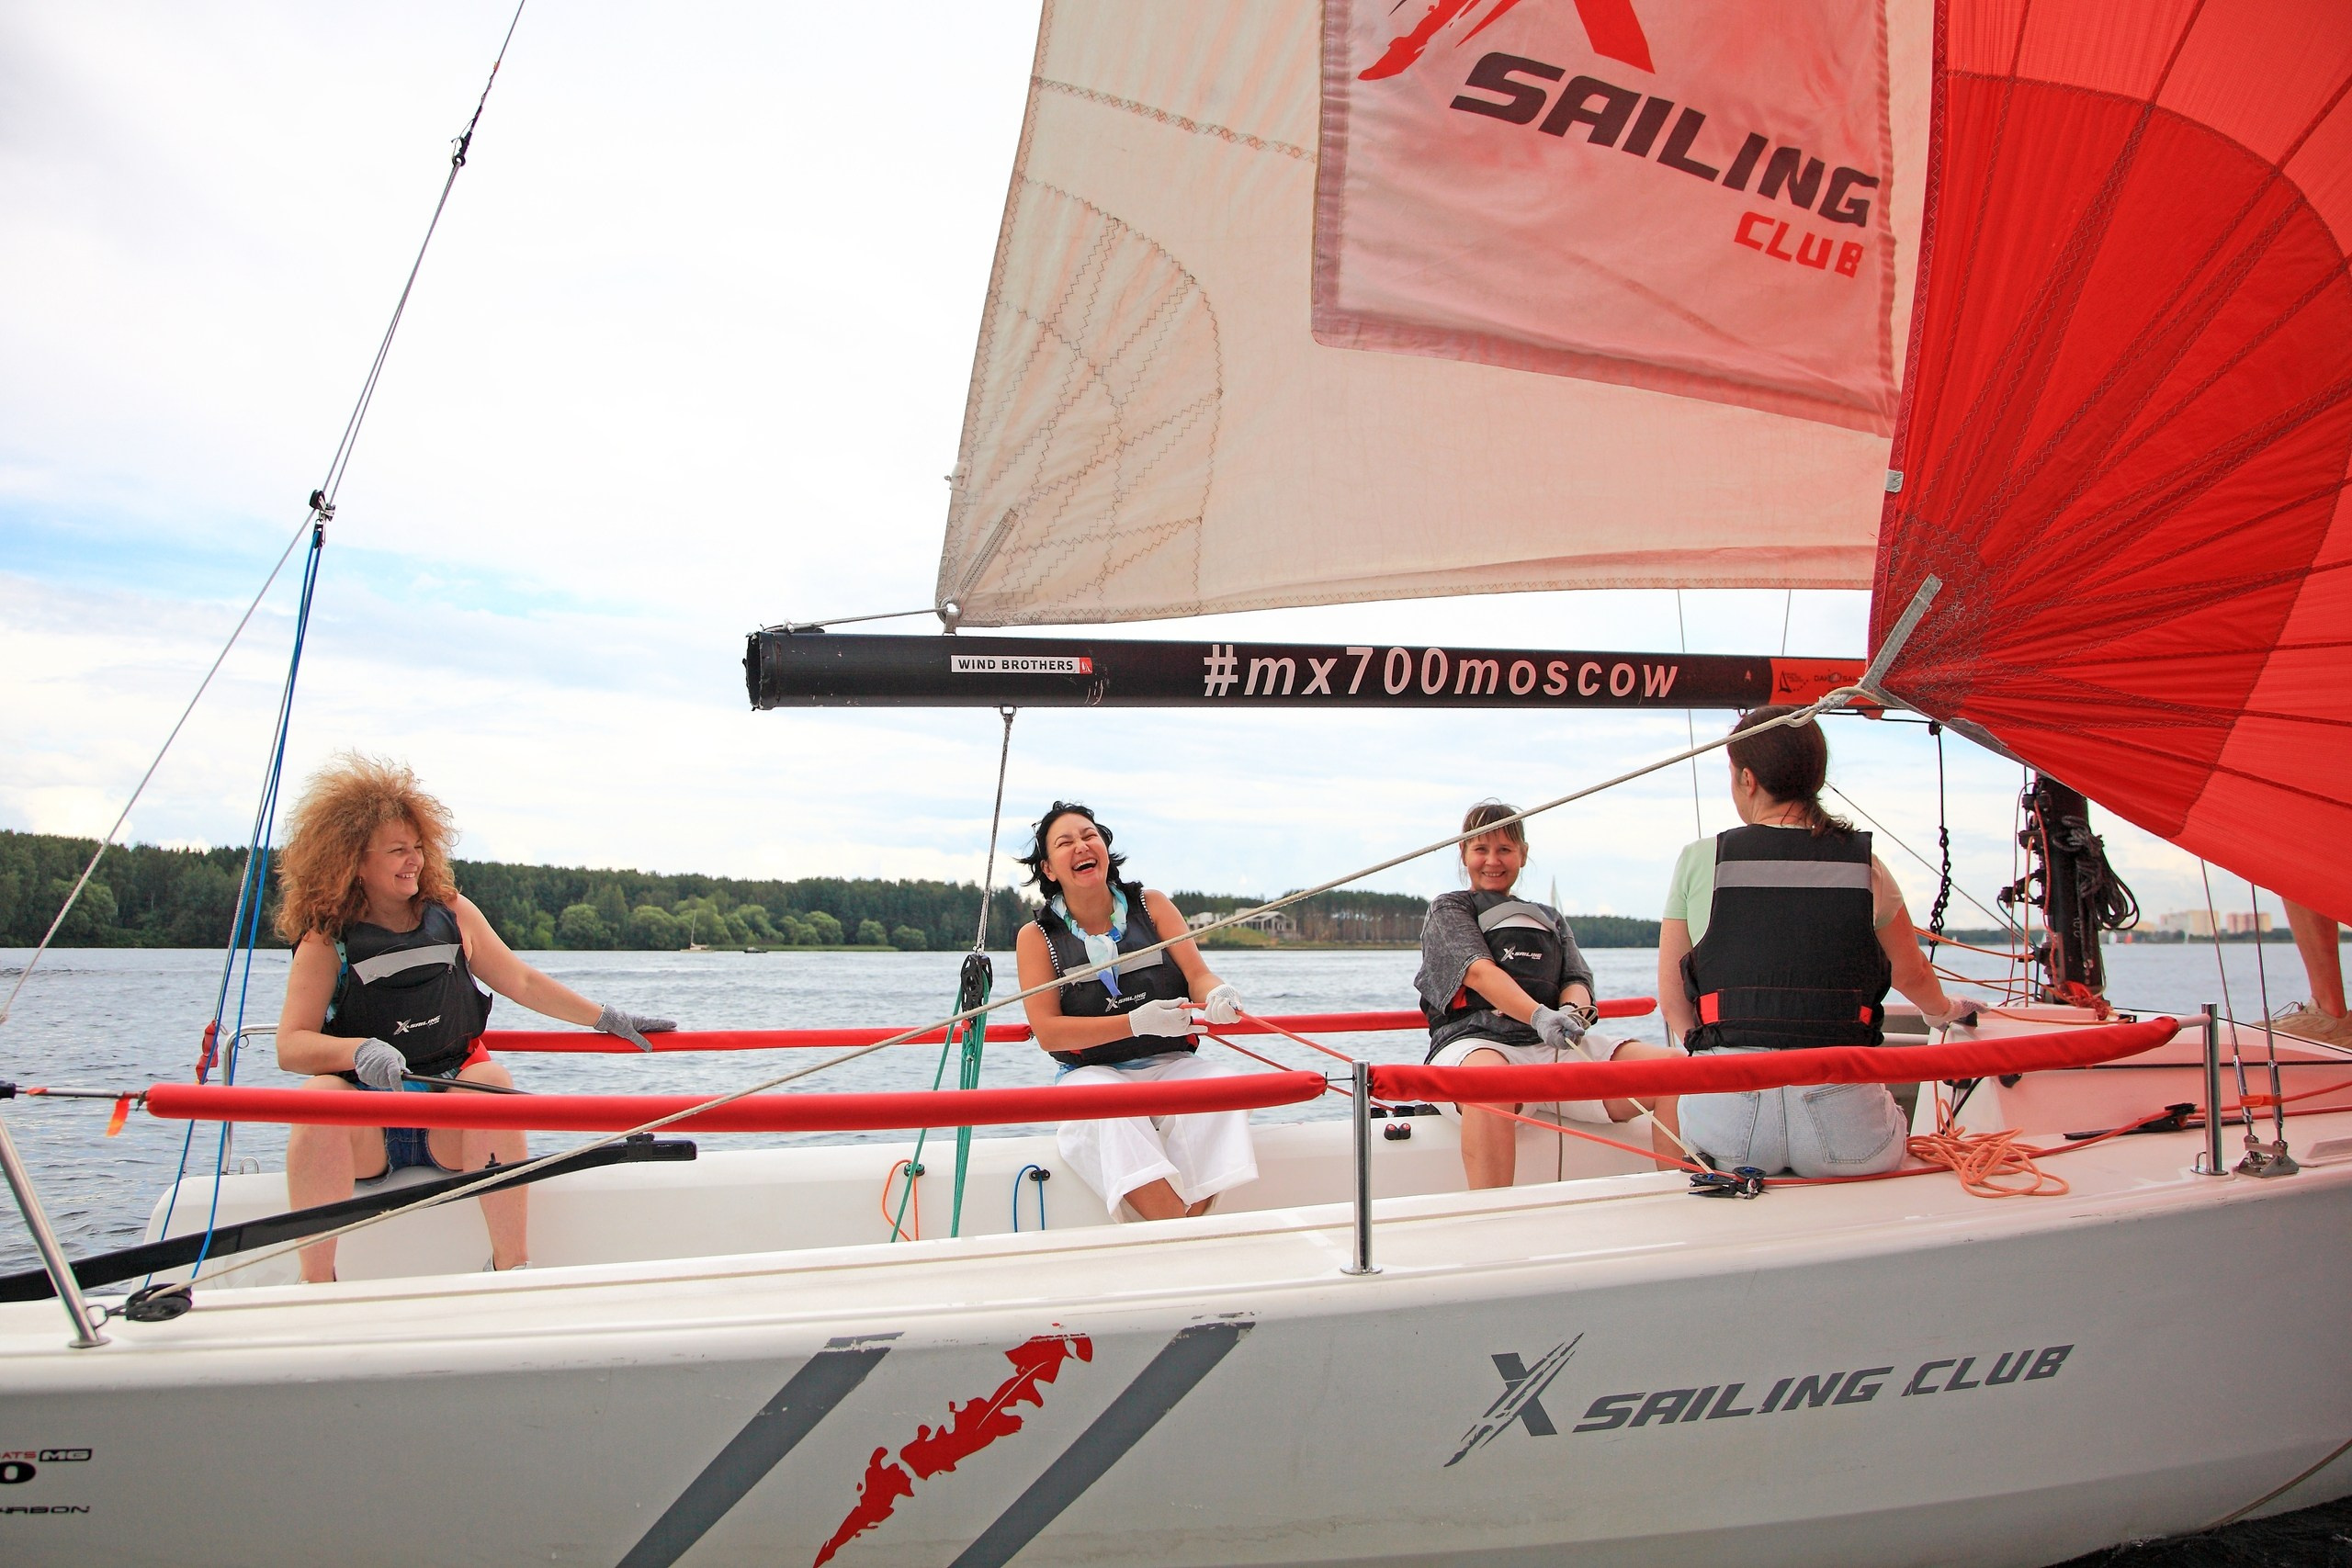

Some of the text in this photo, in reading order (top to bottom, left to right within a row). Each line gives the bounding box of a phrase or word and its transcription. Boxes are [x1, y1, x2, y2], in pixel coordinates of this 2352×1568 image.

[1450, 52, 1880, 228] SAILING
[1735, 211, 1864, 278] CLUB
[958, 659, 1074, 671] WIND BROTHERS
[1204, 644, 1679, 698] #mx700moscow
[1572, 1366, 1894, 1434] SAILING
[1901, 1344, 2075, 1397] CLUB
[0, 1451, 37, 1460] ATS
